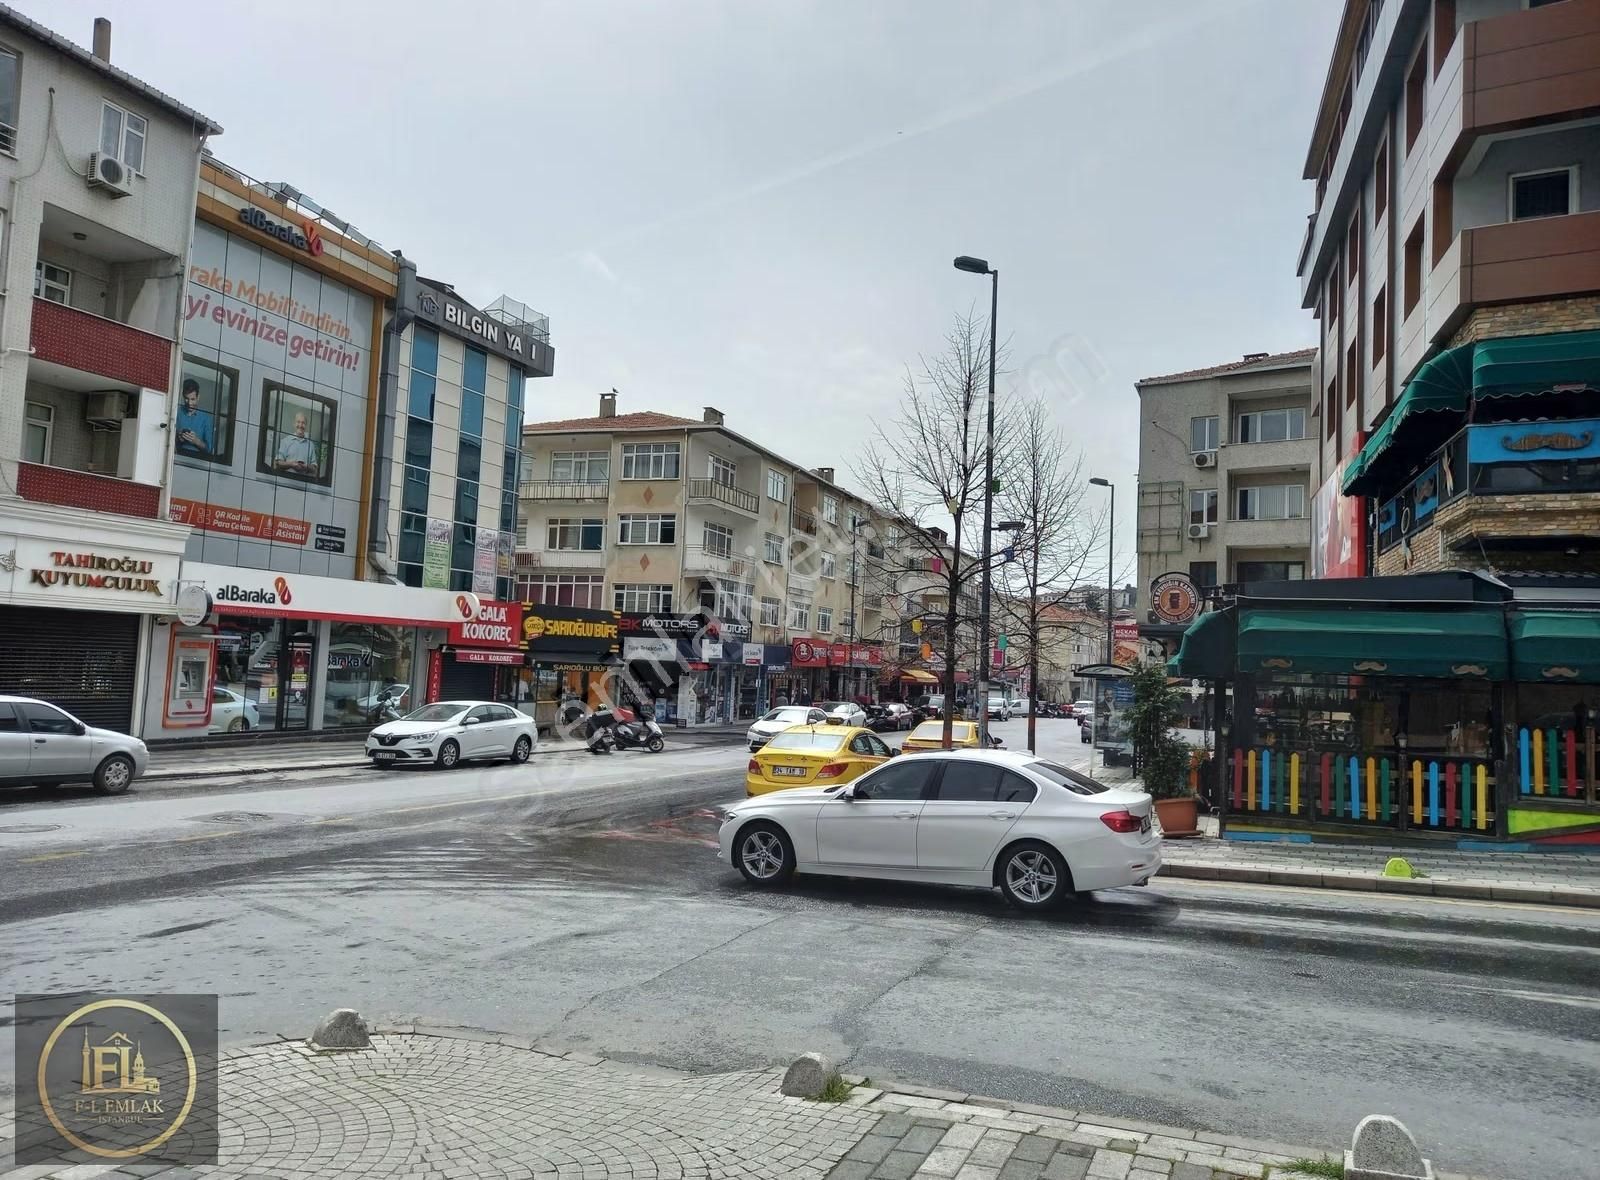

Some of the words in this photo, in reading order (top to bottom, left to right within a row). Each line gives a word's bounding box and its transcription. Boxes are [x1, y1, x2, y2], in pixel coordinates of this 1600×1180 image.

[240, 207, 306, 249] alBaraka
[211, 307, 288, 347] evinize
[288, 333, 360, 372] getirin!
[212, 519, 231, 528] Para
[215, 510, 226, 519] QR
[226, 511, 241, 520] Kod
[275, 528, 306, 541] Asistan
[50, 551, 154, 575] TAHİROĞLU
[31, 568, 164, 597] KUYUMCULUK
[216, 584, 276, 604] alBaraka
[479, 604, 508, 623] GALA
[462, 623, 513, 643] KOKOREÇ
[544, 618, 593, 637] SARIOĞLU
[593, 620, 618, 639] BÜFE
[642, 619, 699, 629] MOTORS
[720, 623, 748, 634] MOTORS
[469, 653, 485, 661] GALA
[552, 663, 591, 672] SARIOĞLU
